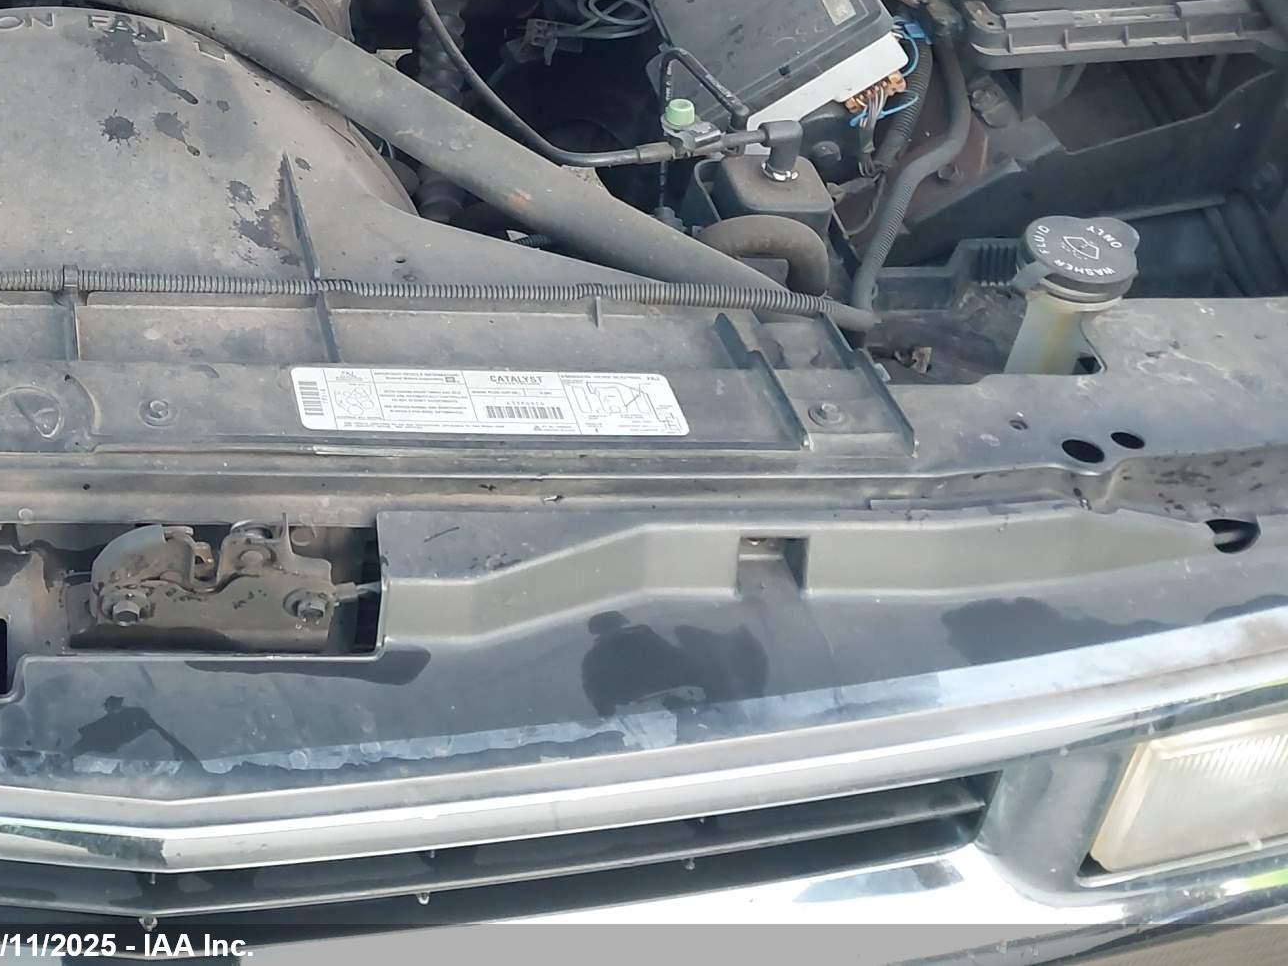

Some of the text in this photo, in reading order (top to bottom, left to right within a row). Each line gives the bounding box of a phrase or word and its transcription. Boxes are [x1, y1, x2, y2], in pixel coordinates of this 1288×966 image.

[87, 13, 169, 43] FAN
[1033, 225, 1123, 277] WASHER FLUID ONLY
[489, 375, 544, 385] CATALYST
